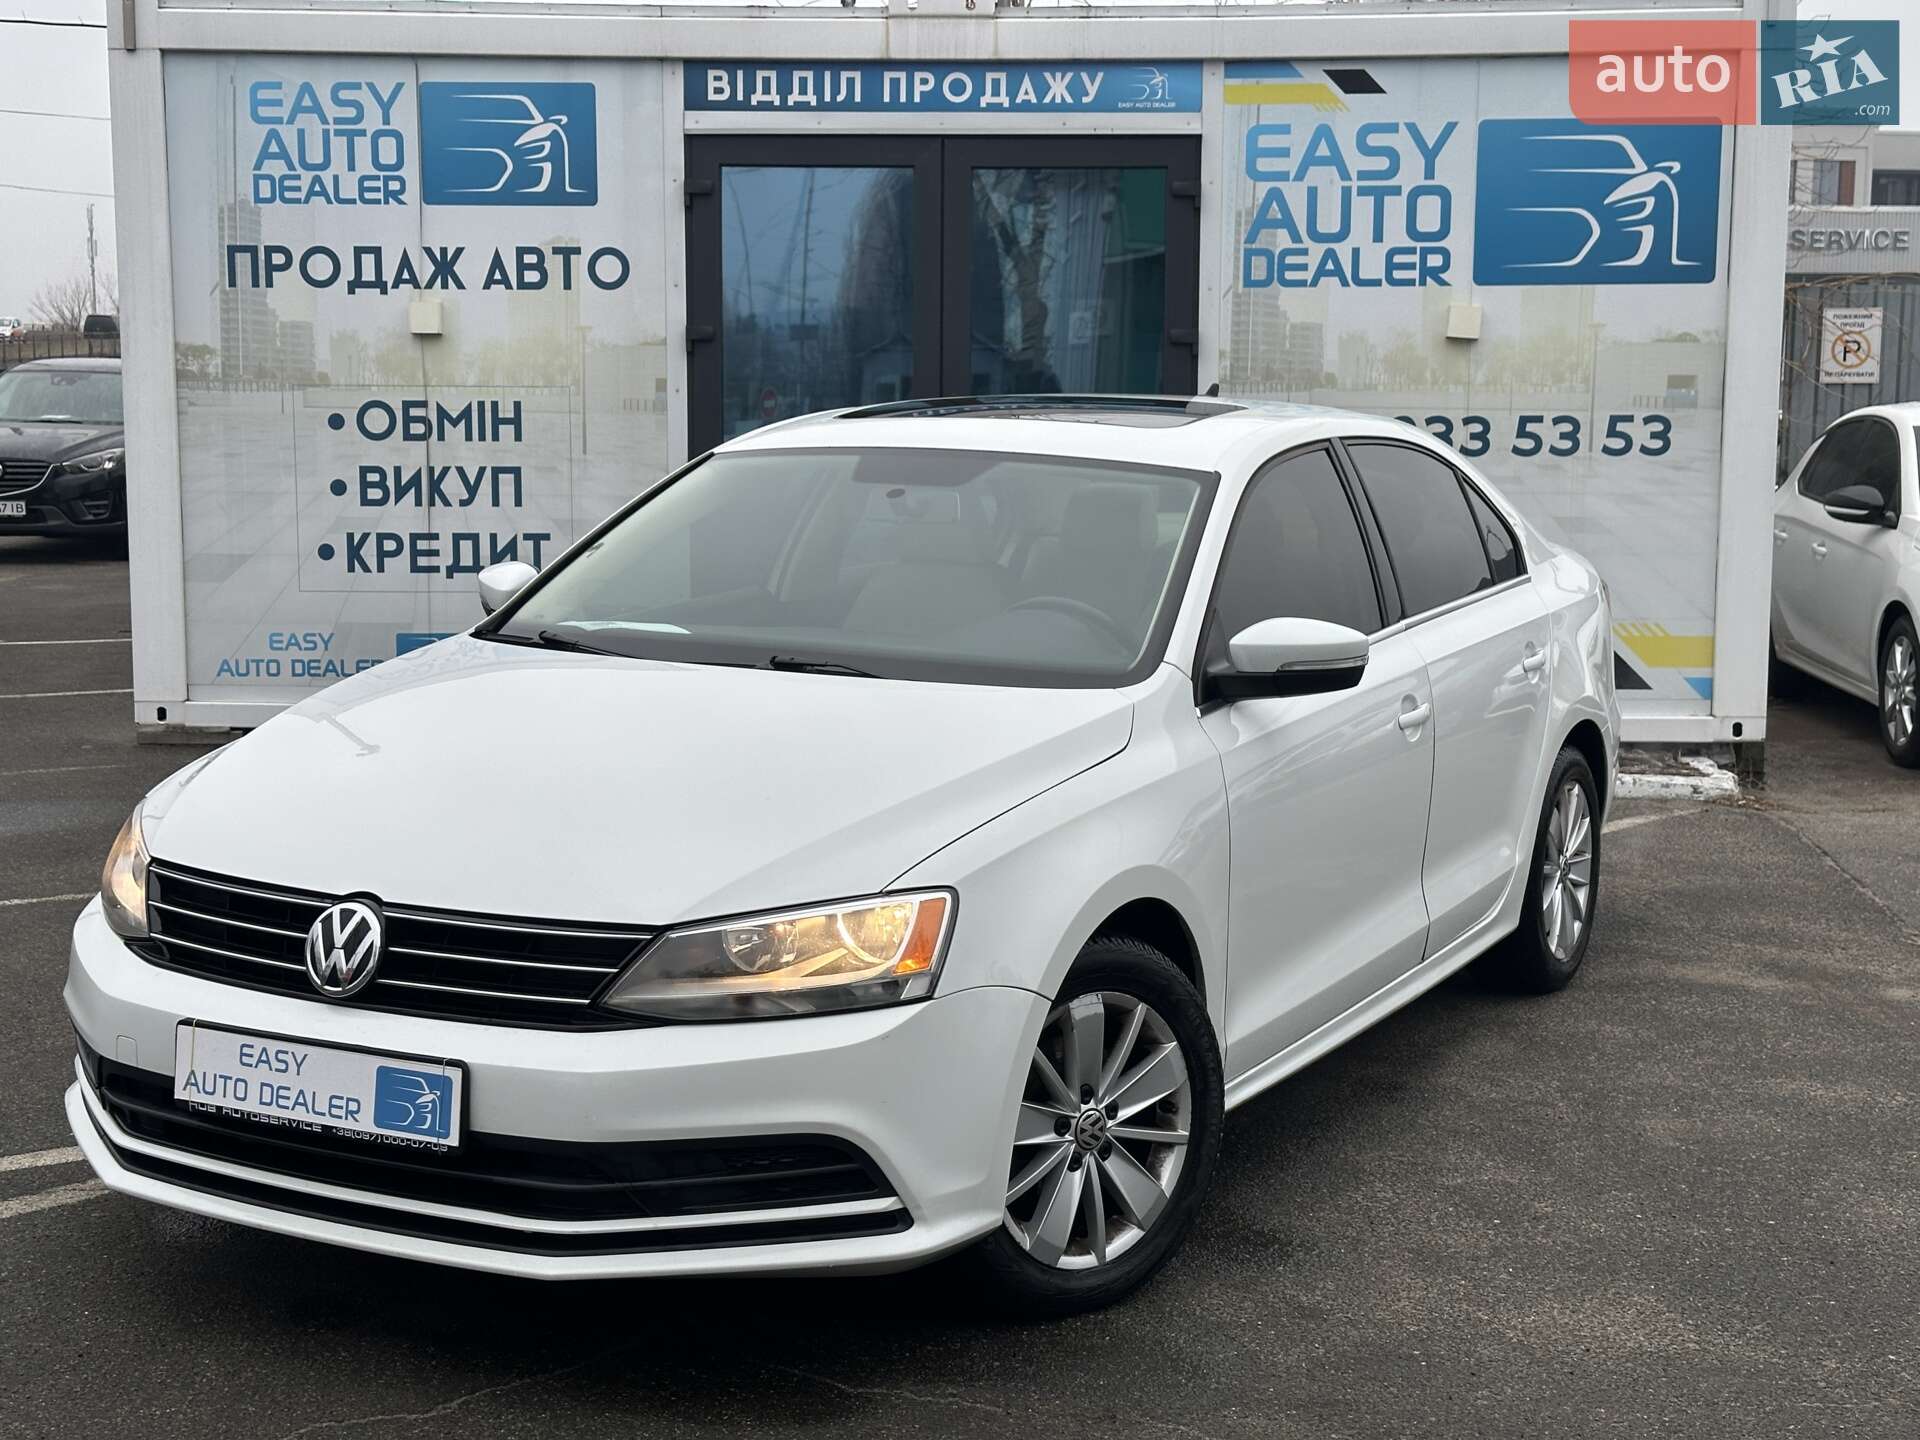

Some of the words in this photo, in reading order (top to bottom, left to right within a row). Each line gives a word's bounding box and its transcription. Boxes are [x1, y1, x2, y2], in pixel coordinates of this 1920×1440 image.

[249, 81, 406, 125] EASY
[706, 69, 862, 106] ВІДДІЛ
[883, 70, 1104, 108] ПРОДАЖУ
[253, 129, 405, 172] AUTO
[1245, 121, 1459, 182] EASY
[253, 174, 408, 205] DEALER
[1245, 184, 1451, 244] AUTO
[1790, 228, 1910, 250] SERVICE
[226, 245, 466, 295] ПРОДАЖ
[482, 246, 630, 291] АВТО
[1243, 246, 1451, 288] DEALER
[356, 400, 522, 442] ОБМІН
[1394, 415, 1491, 457] 33
[1511, 415, 1581, 457] 53
[1601, 414, 1672, 457] 53
[359, 466, 522, 508] ВИКУП
[346, 532, 551, 579] КРЕДИТ
[268, 632, 334, 651] EASY
[216, 659, 280, 677] AUTO
[239, 1043, 309, 1076] EASY
[182, 1070, 248, 1102] AUTO
[259, 1081, 361, 1123] DEALER
[222, 1107, 323, 1132] AUTOSERVICE
